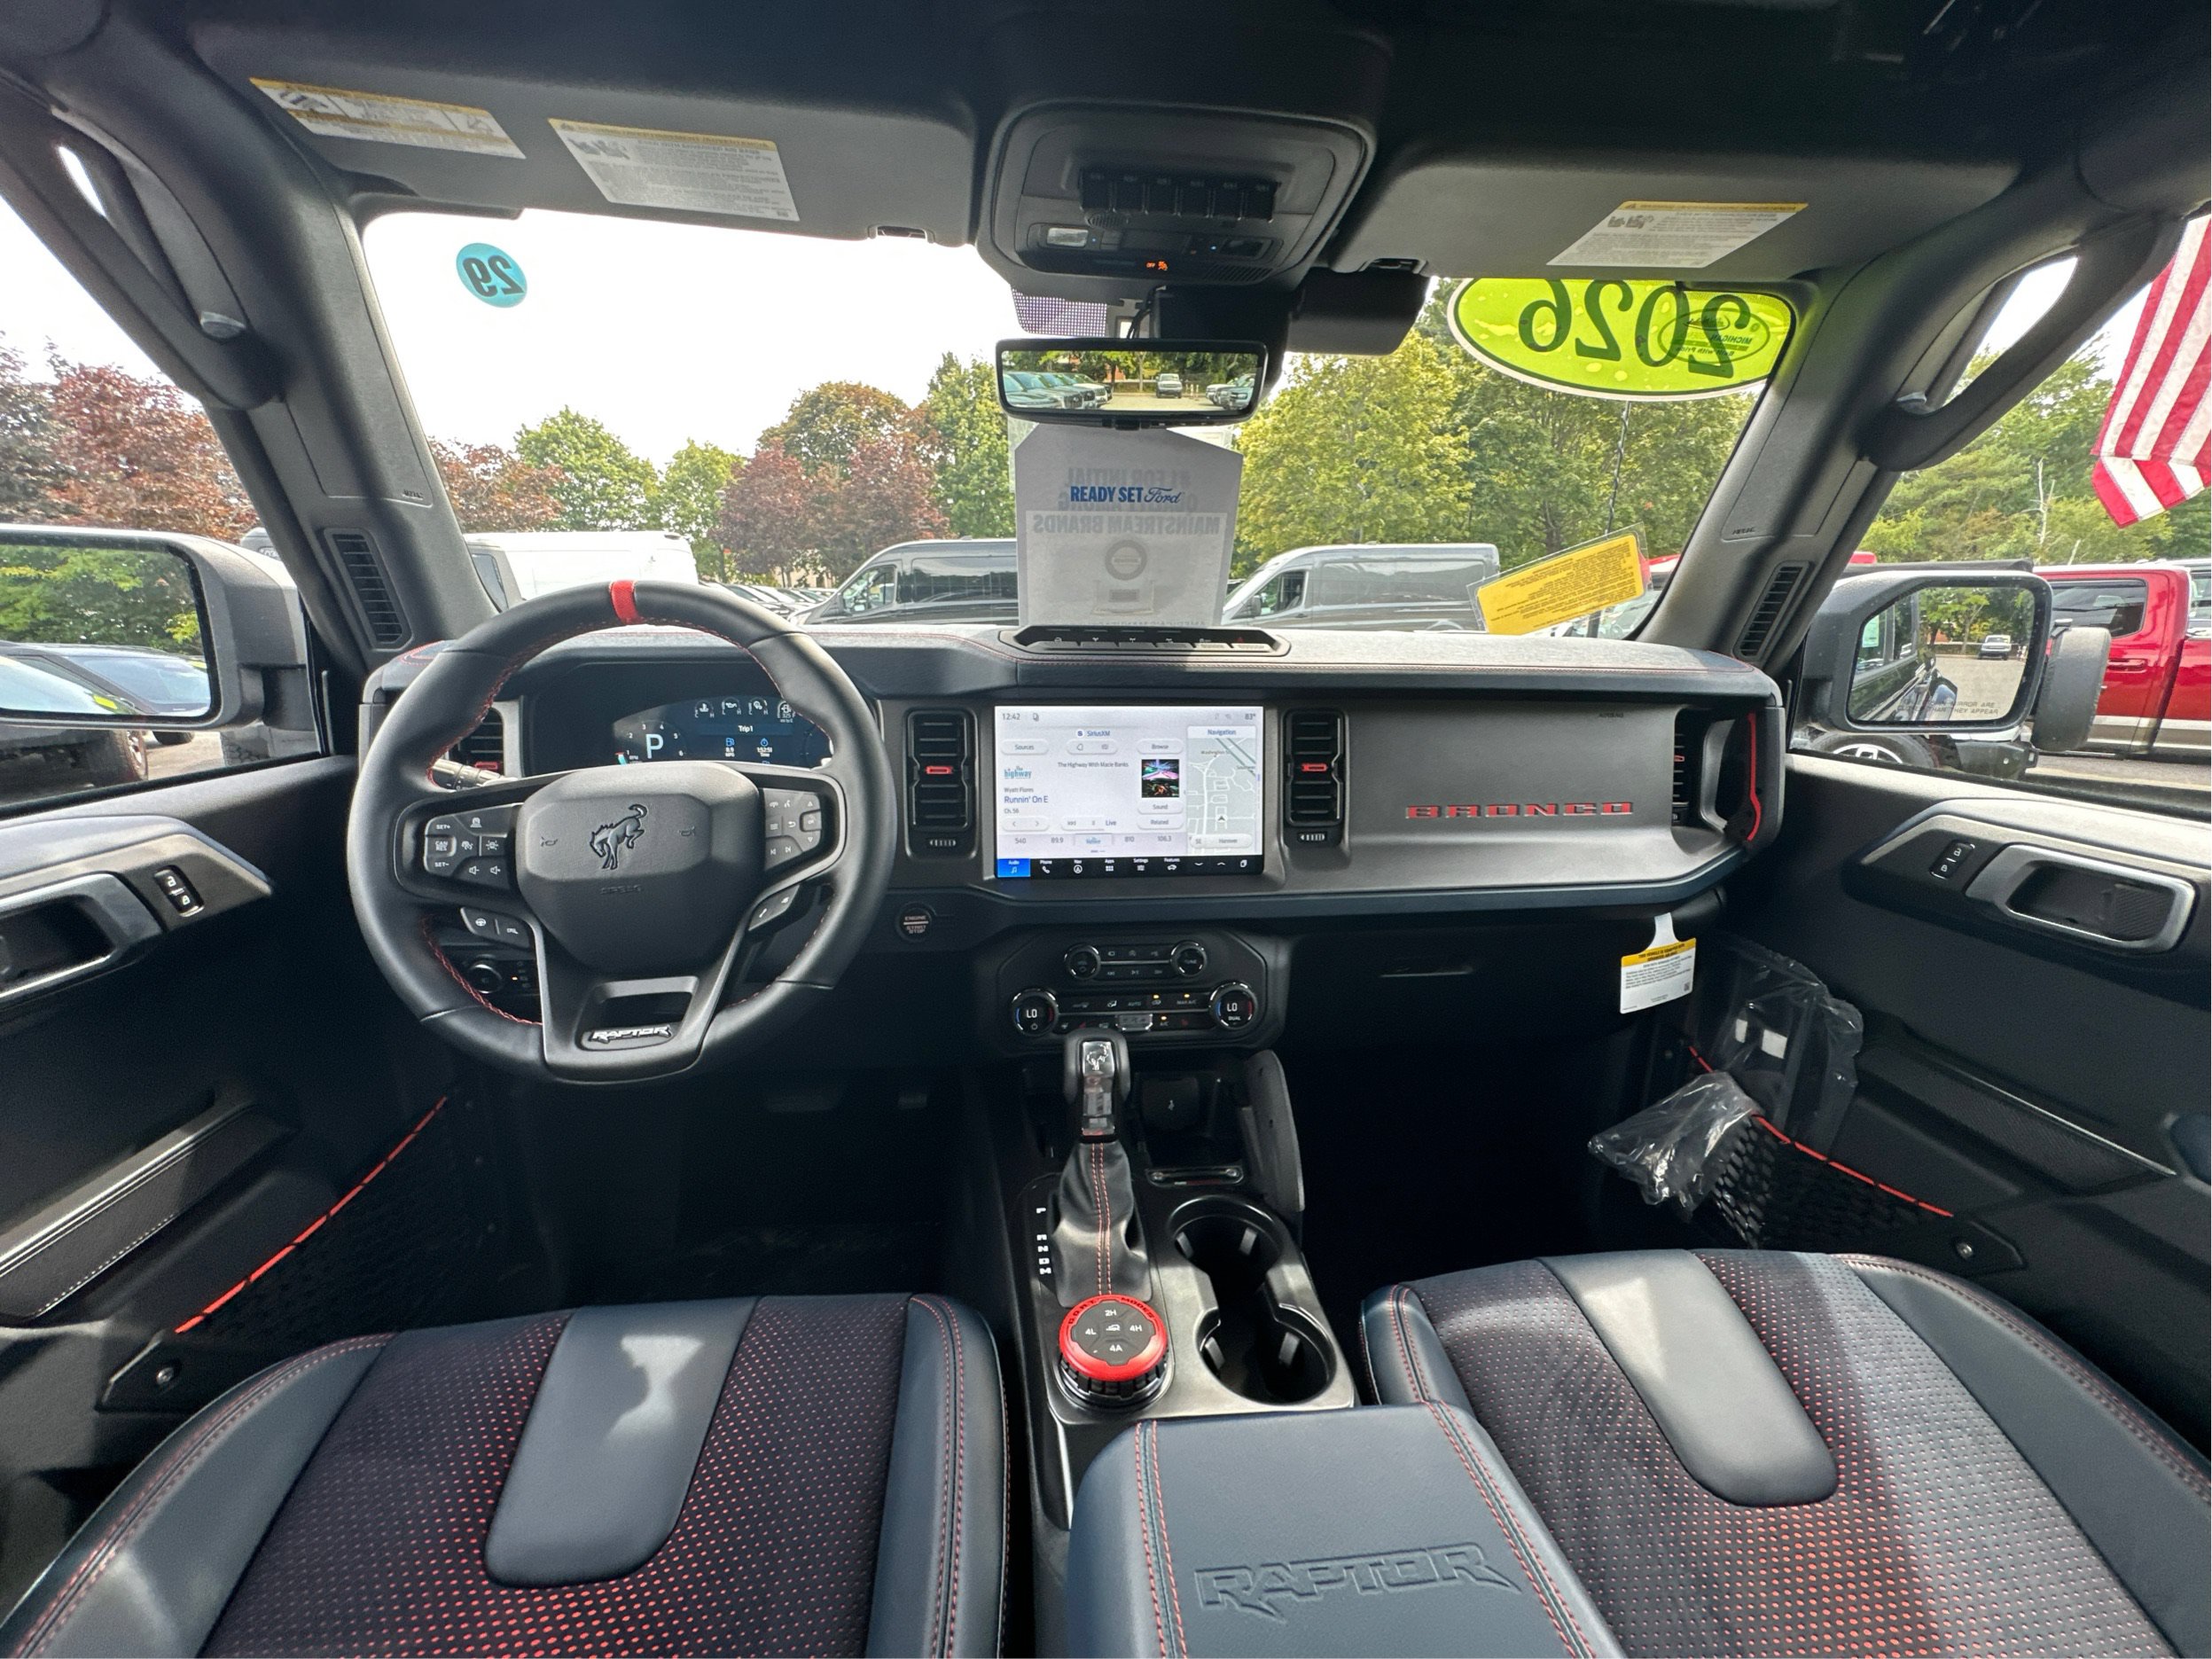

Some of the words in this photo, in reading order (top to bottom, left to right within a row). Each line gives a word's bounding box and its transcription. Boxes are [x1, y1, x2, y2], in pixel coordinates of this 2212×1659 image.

[1070, 486, 1117, 503] READY
[1119, 486, 1145, 503] SET
[1145, 487, 1184, 505] Ford
[738, 724, 750, 733] Trip
[645, 733, 664, 759] P
[1004, 769, 1032, 779] highway
[1404, 801, 1633, 819] BRONCO
[1026, 1008, 1037, 1019] LO
[1226, 1002, 1238, 1012] LO
[589, 1025, 671, 1043] RAPTOR
[1121, 1296, 1155, 1319] MODES
[1193, 1542, 1522, 1624] RAPTOR
